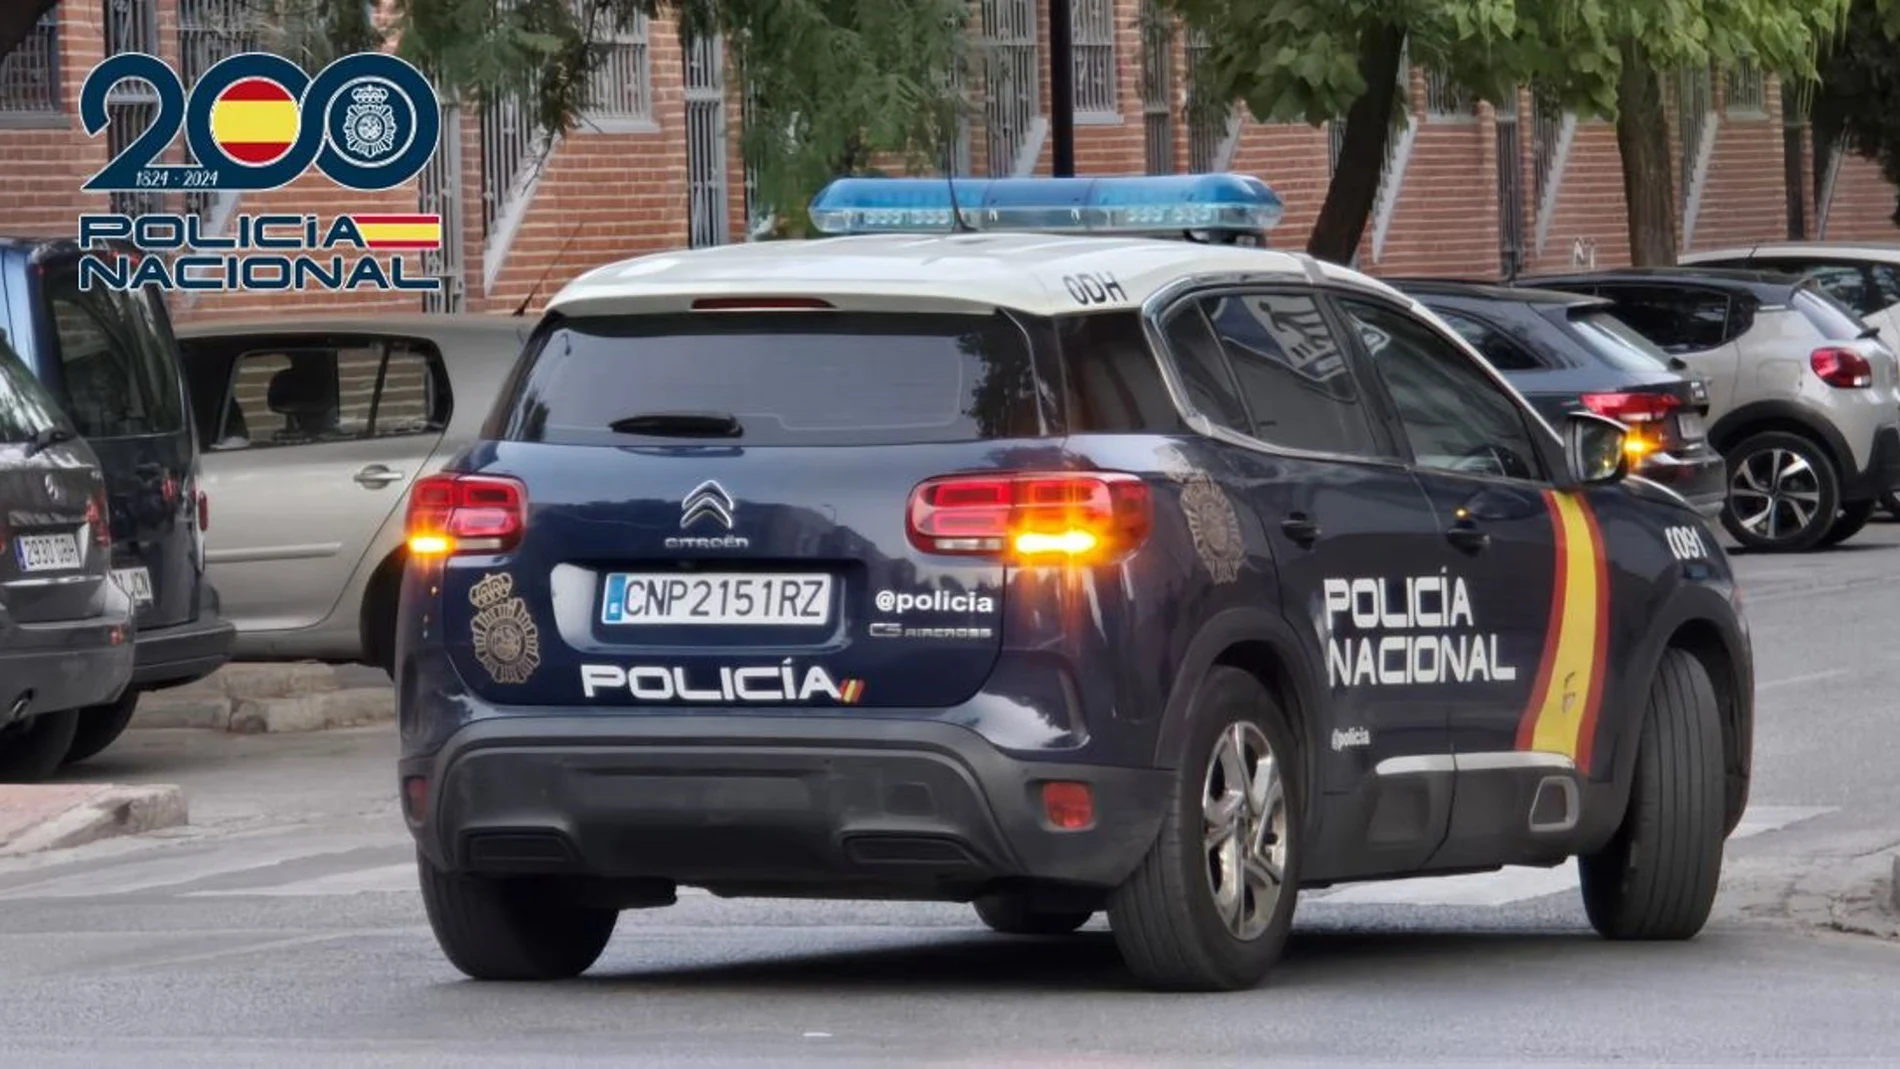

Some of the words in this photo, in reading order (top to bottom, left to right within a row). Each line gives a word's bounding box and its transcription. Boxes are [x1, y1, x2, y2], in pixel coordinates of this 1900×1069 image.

[624, 579, 824, 617] CNP2151RZ
[875, 590, 993, 614] @policia
[1323, 565, 1474, 630] POLICÍA
[580, 656, 842, 701] POLICÍA
[1328, 633, 1516, 688] NACIONAL
